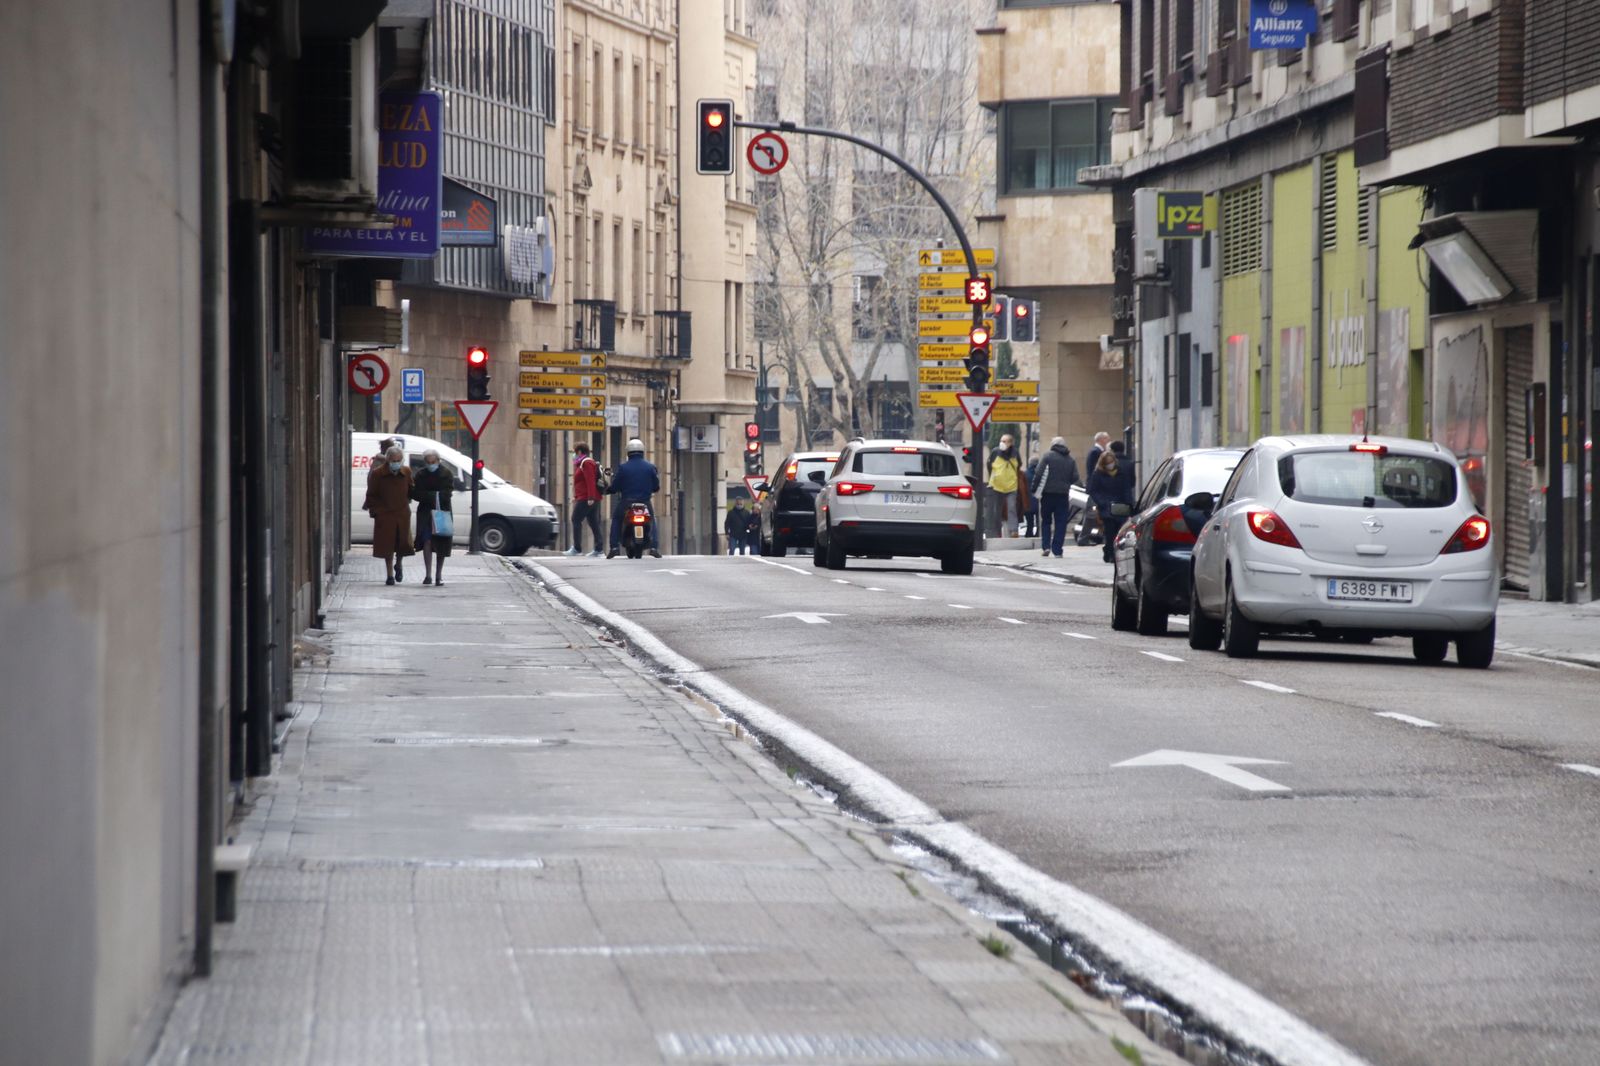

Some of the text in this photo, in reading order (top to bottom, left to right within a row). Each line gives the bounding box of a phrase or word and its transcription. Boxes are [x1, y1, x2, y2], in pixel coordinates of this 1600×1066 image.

[1254, 17, 1303, 32] Allianz
[1261, 33, 1296, 46] Seguros
[1159, 195, 1202, 231] lpz
[313, 228, 428, 242] PARA ELLA Y EL
[970, 282, 987, 300] 36
[1341, 582, 1407, 597] 6389 FWT
